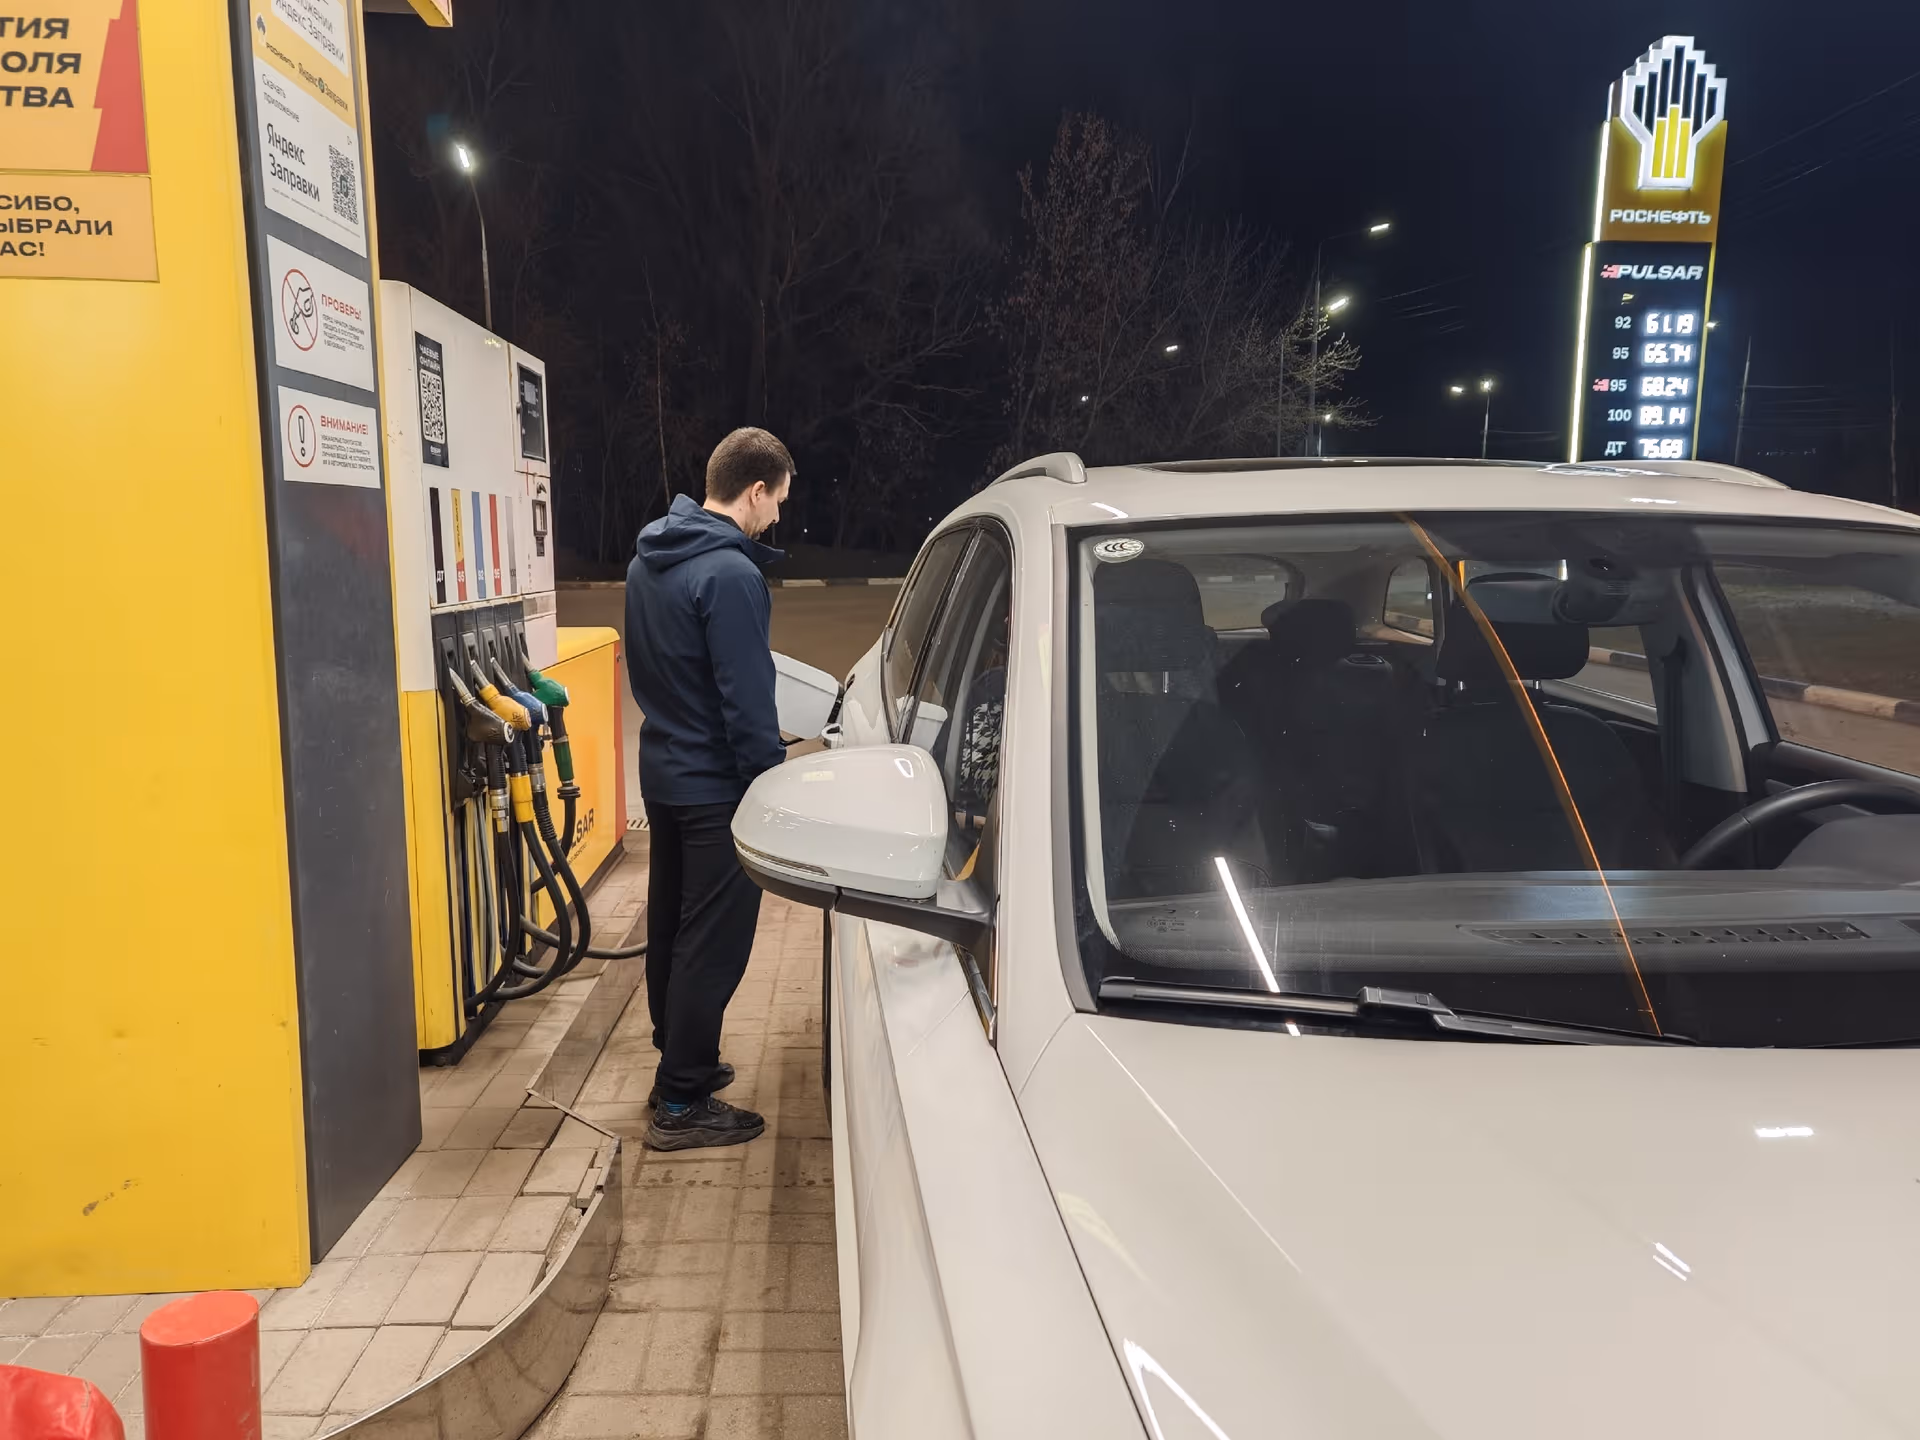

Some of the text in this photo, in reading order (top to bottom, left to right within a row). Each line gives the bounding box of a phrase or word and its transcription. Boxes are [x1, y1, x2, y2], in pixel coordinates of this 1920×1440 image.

[0, 17, 69, 39] ТИЯ
[1, 51, 82, 74] ОЛЯ
[262, 73, 286, 99] Скачать
[0, 86, 74, 108] ТВА
[263, 91, 300, 123] приложение
[267, 123, 306, 166] Яндекс
[269, 153, 320, 202] Заправки
[0, 194, 80, 214] СИБО,
[1609, 209, 1712, 225] РОСНЕФТЬ
[0, 241, 45, 257] АС!
[1616, 264, 1704, 280] PULSAR
[321, 293, 362, 321] ПРОВЕРЬ!
[1614, 316, 1632, 329] 92
[1612, 347, 1630, 360] 95
[1610, 379, 1627, 392] 95
[320, 415, 369, 435] ВНИМАНИЕ!
[1607, 409, 1632, 422] 100
[1604, 441, 1627, 456] ДТ
